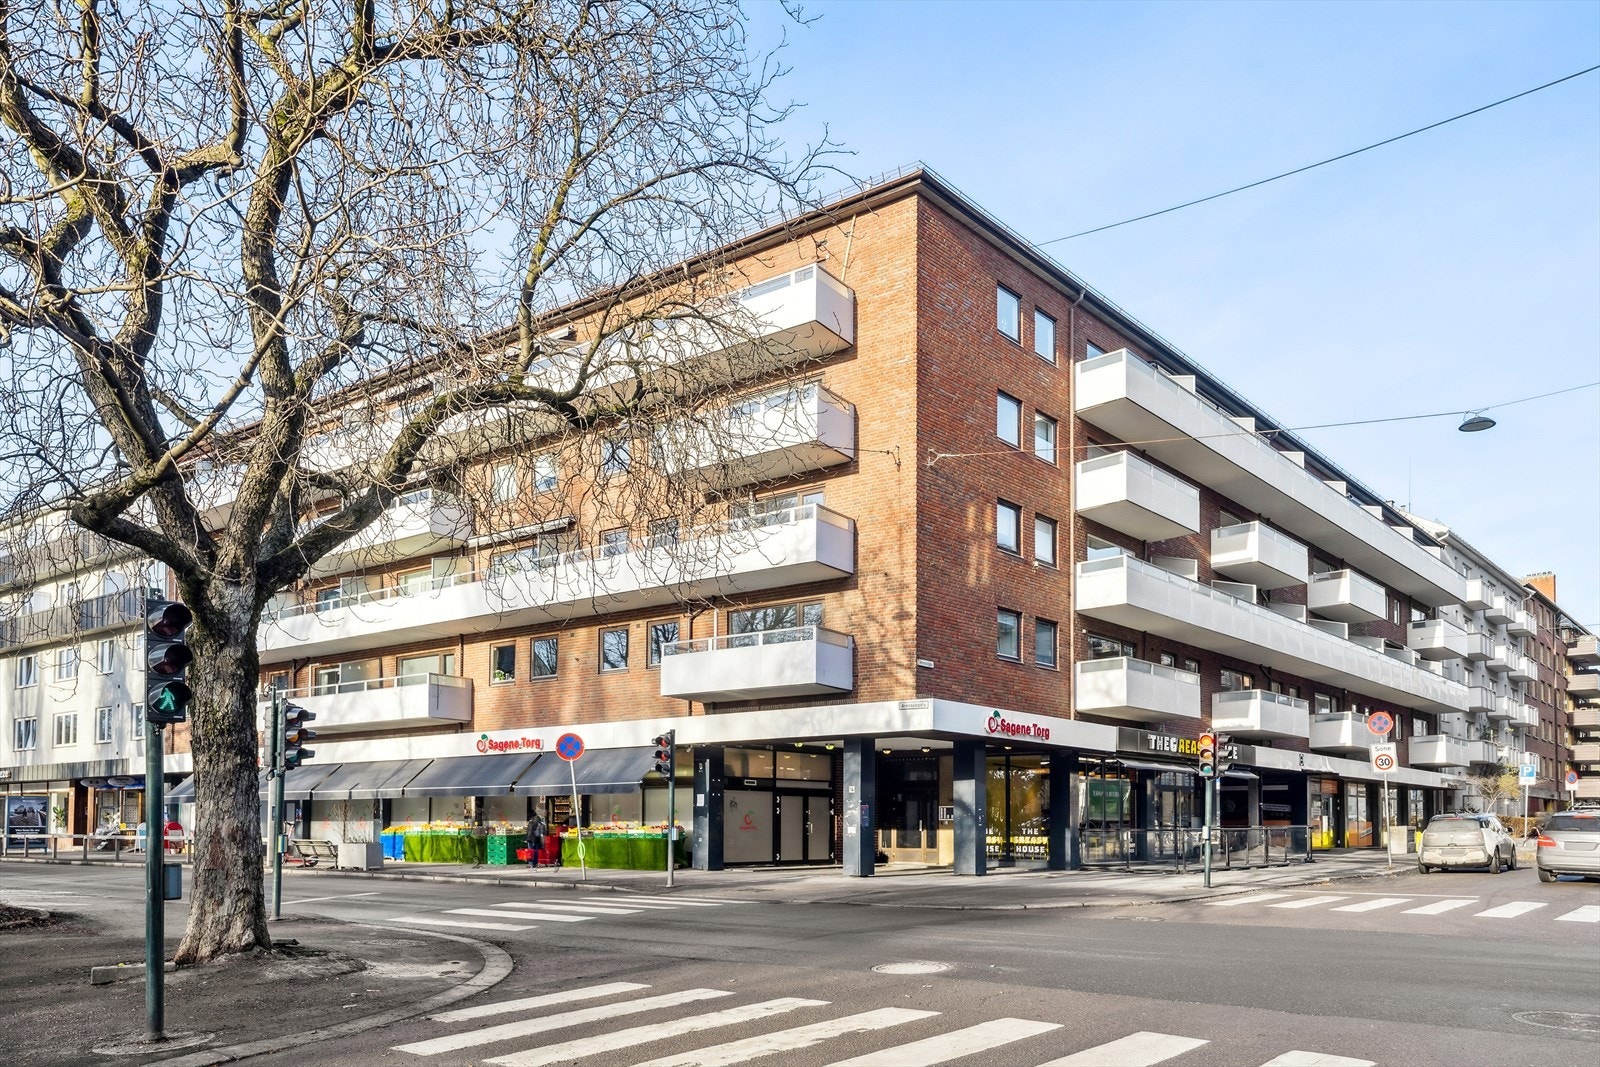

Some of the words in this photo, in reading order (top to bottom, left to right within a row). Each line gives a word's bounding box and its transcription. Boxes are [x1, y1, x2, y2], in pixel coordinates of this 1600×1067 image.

[1000, 718, 1031, 737] Sagene
[1032, 723, 1050, 741] Torg
[488, 739, 519, 752] Sagene
[521, 736, 541, 750] Torg
[1378, 757, 1391, 767] 30
[1523, 766, 1532, 776] P
[1021, 827, 1039, 835] THE
[1016, 845, 1046, 853] HOUSE
